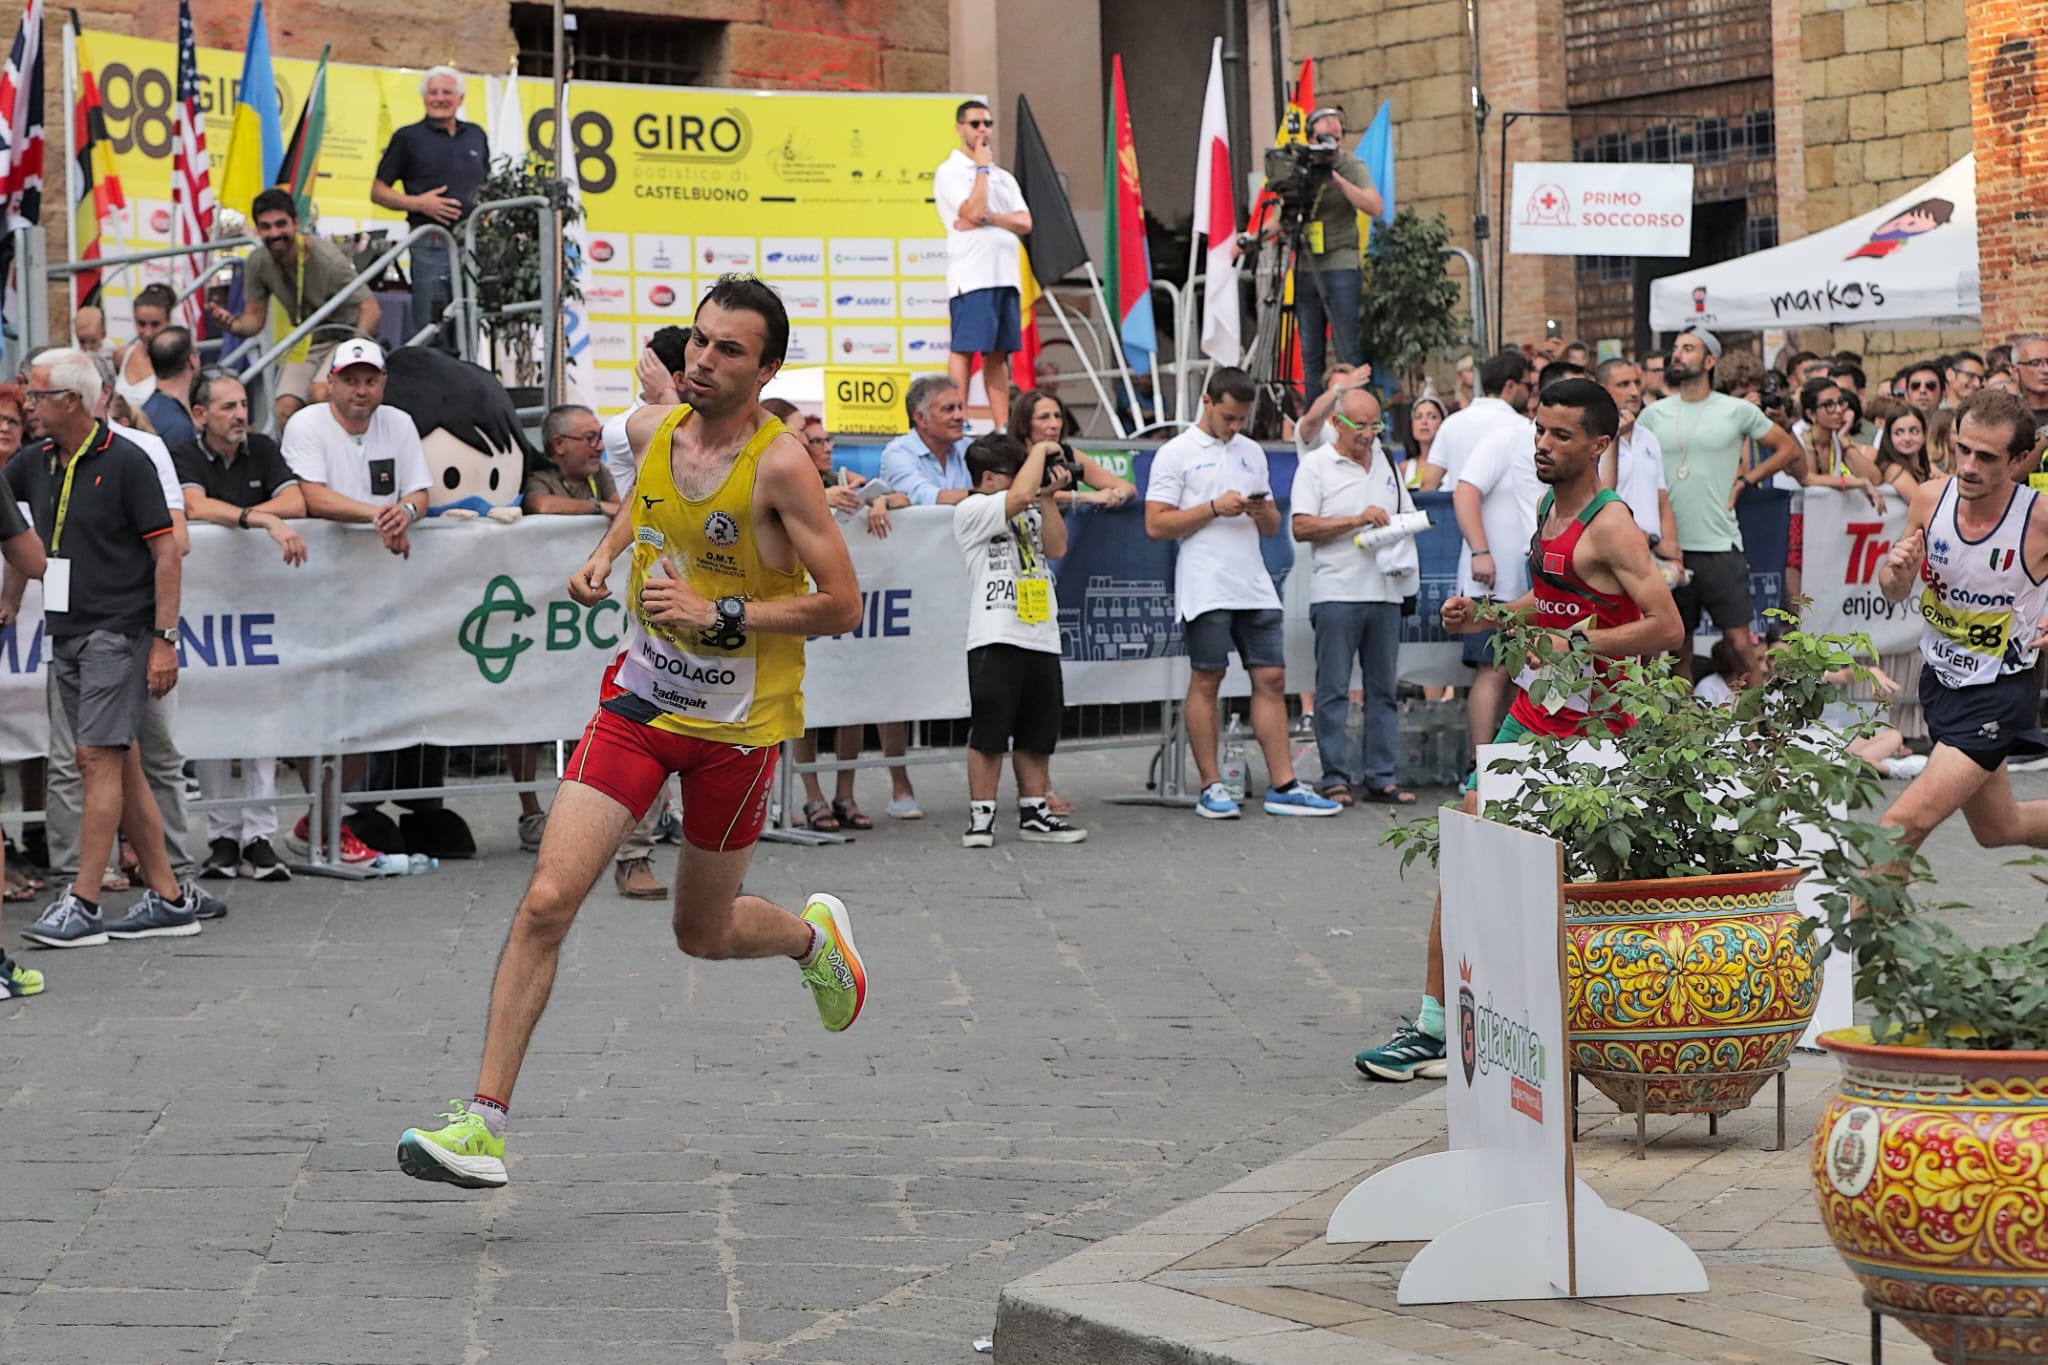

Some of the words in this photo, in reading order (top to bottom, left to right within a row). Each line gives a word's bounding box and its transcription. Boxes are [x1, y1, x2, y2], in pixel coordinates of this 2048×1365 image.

[100, 62, 174, 159] 98
[634, 113, 741, 152] GIRO
[633, 165, 722, 180] podistico
[731, 167, 748, 181] di
[634, 185, 749, 201] CASTELBUONO
[1582, 192, 1641, 205] PRIMO
[1582, 213, 1684, 227] SOCCORSO
[838, 380, 894, 403] GIRO
[706, 552, 735, 565] O.M.T.
[1842, 591, 1896, 620] enjoy
[1922, 604, 1957, 629] GIRO
[1968, 624, 2002, 648] 98
[1932, 640, 1979, 673] ALFIERI
[828, 948, 855, 990] HOKA
